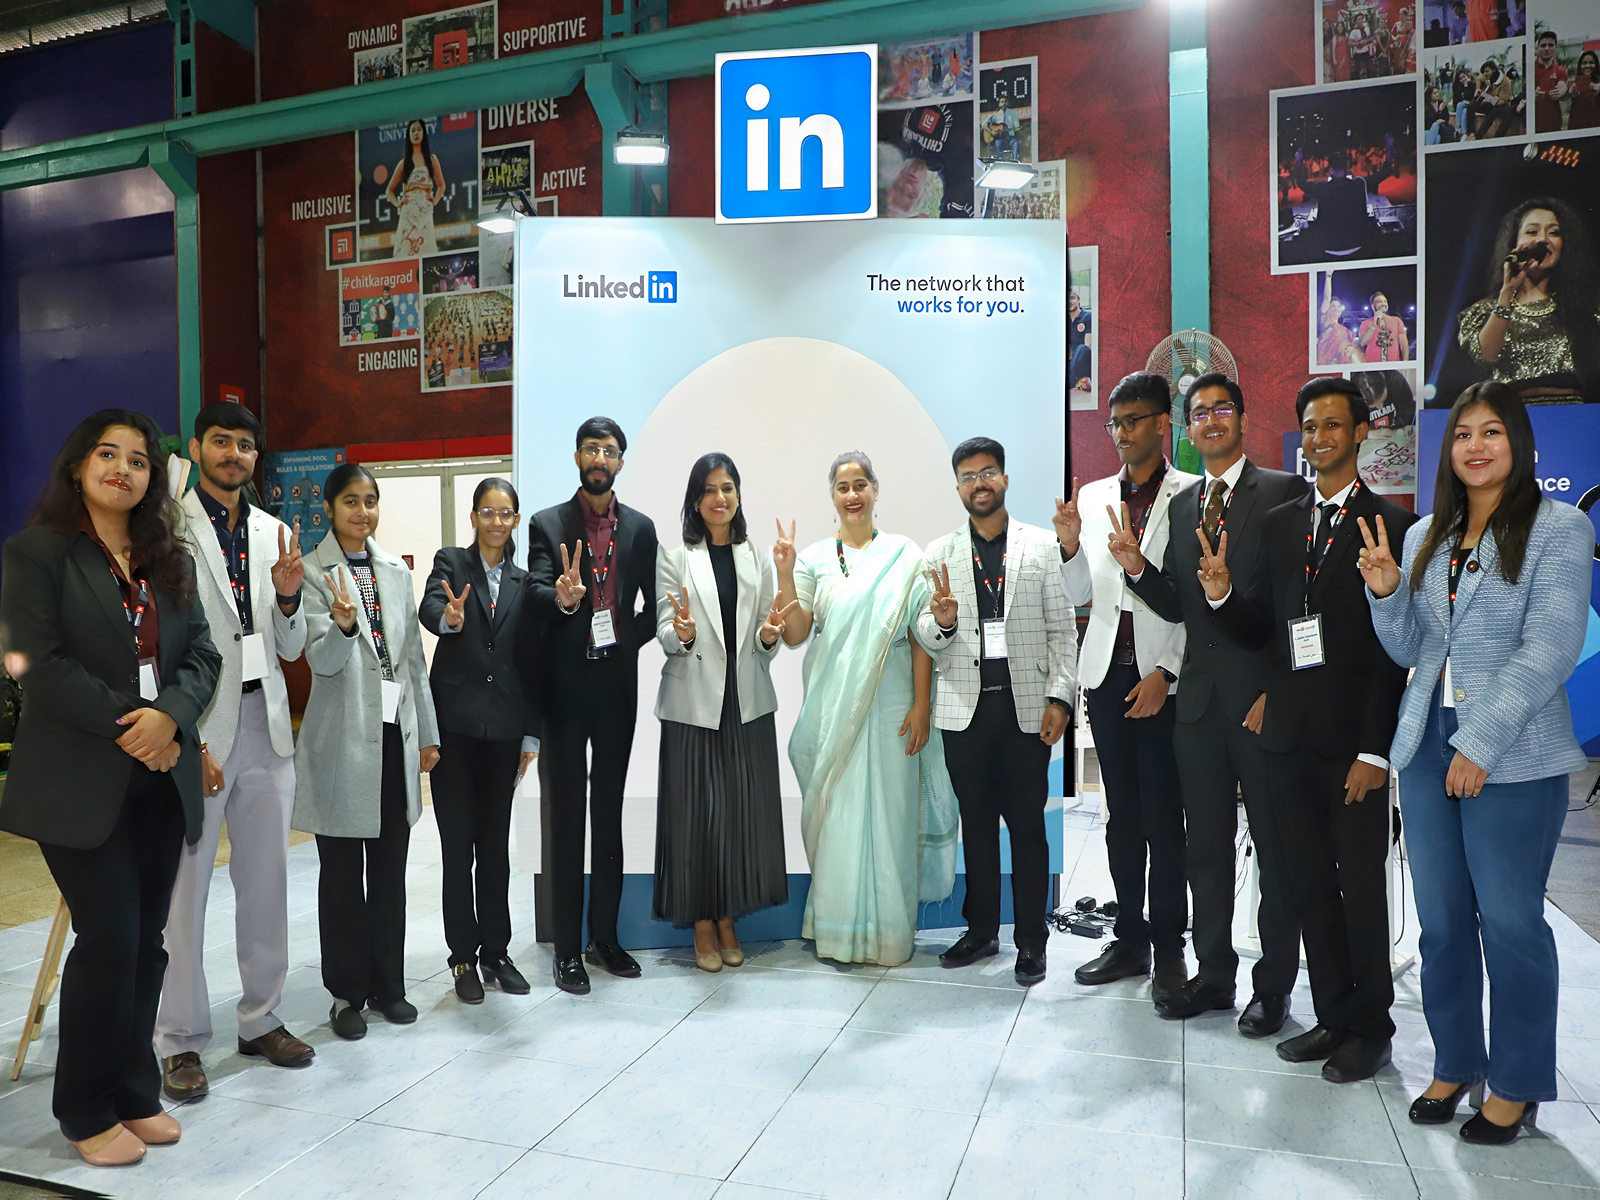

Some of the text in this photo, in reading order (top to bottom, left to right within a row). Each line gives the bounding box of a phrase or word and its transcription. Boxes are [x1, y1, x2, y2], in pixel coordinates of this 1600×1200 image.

[348, 24, 397, 49] DYNAMIC
[503, 17, 586, 52] SUPPORTIVE
[488, 98, 559, 130] DIVERSE
[745, 83, 845, 192] in
[541, 166, 586, 191] ACTIVE
[292, 194, 352, 221] INCLUSIVE
[342, 269, 413, 291] #chitkaragrad
[866, 274, 1025, 291] The network that
[897, 296, 1024, 317] works for you.
[358, 348, 418, 372] ENGAGING
